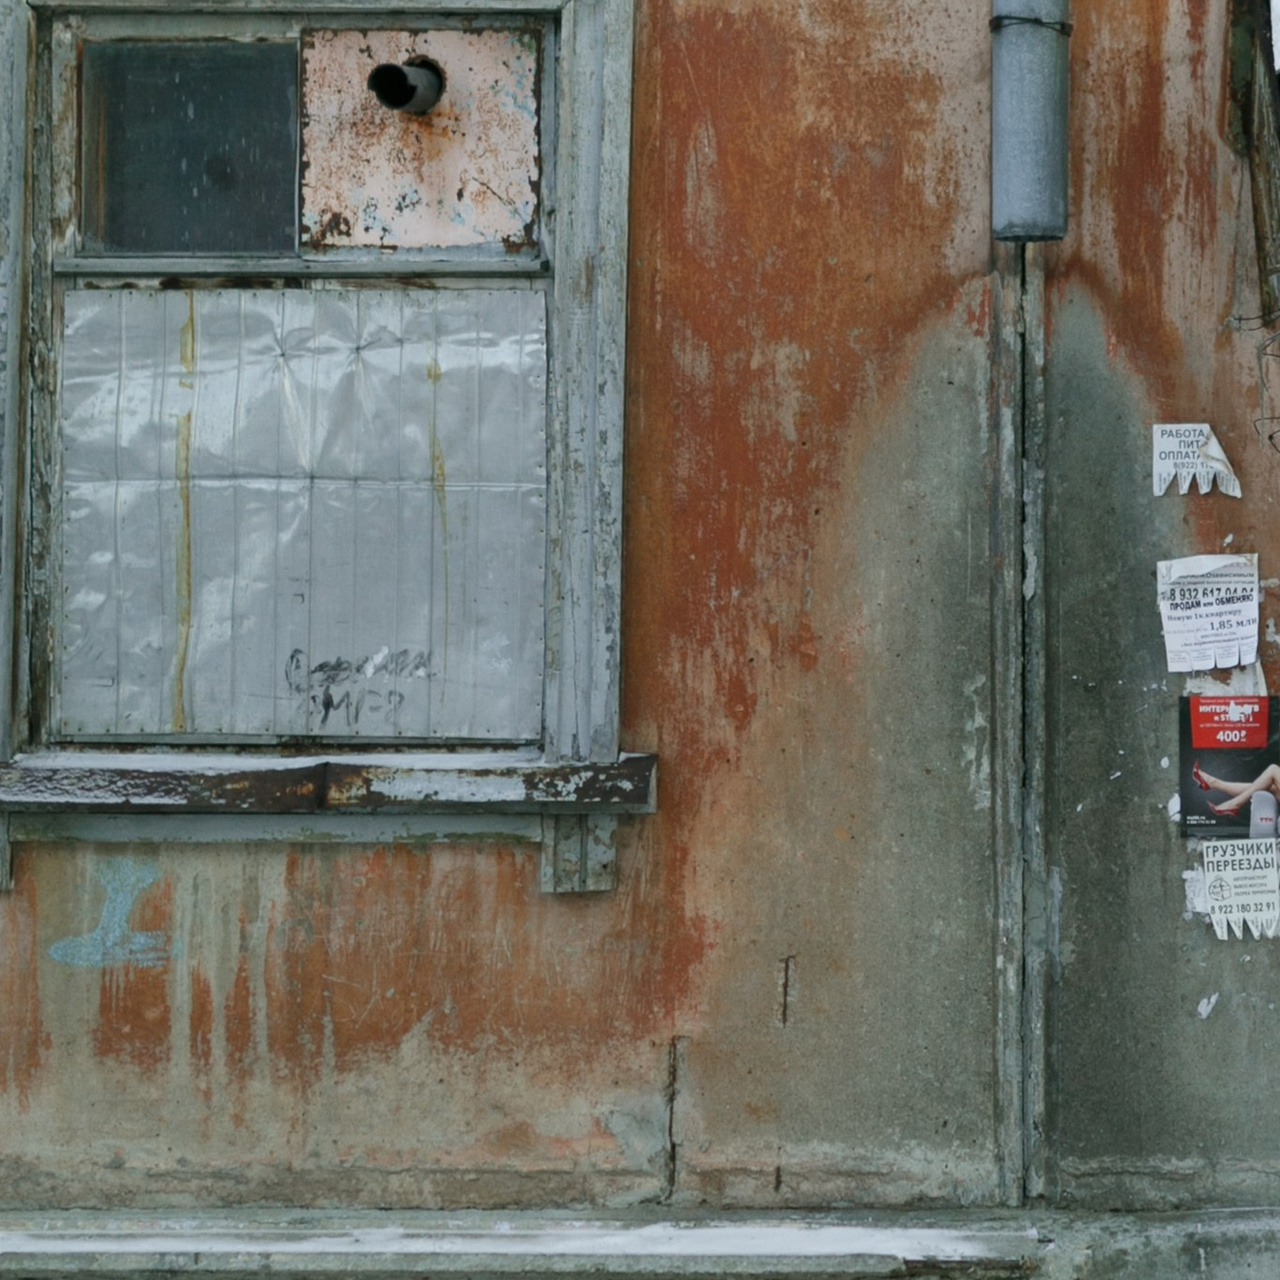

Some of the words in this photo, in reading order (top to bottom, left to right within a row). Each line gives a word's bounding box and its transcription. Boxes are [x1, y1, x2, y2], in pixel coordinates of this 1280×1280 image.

[1161, 429, 1205, 438] РАБОТА
[1179, 440, 1201, 449] ПИТ
[1179, 588, 1199, 601] 932
[1170, 600, 1201, 612] ПРОДАМ
[1215, 594, 1254, 606] ОБМЕНЯЮ
[1209, 620, 1234, 631] 1,85
[1205, 842, 1274, 858] ГРУЗЧИКИ
[1206, 857, 1275, 872] ПЕРЕЕЗДЫ
[1210, 905, 1216, 915] 8
[1218, 904, 1233, 914] 922
[1236, 903, 1251, 913] 180
[1253, 902, 1263, 912] 32
[1266, 902, 1276, 911] 91
